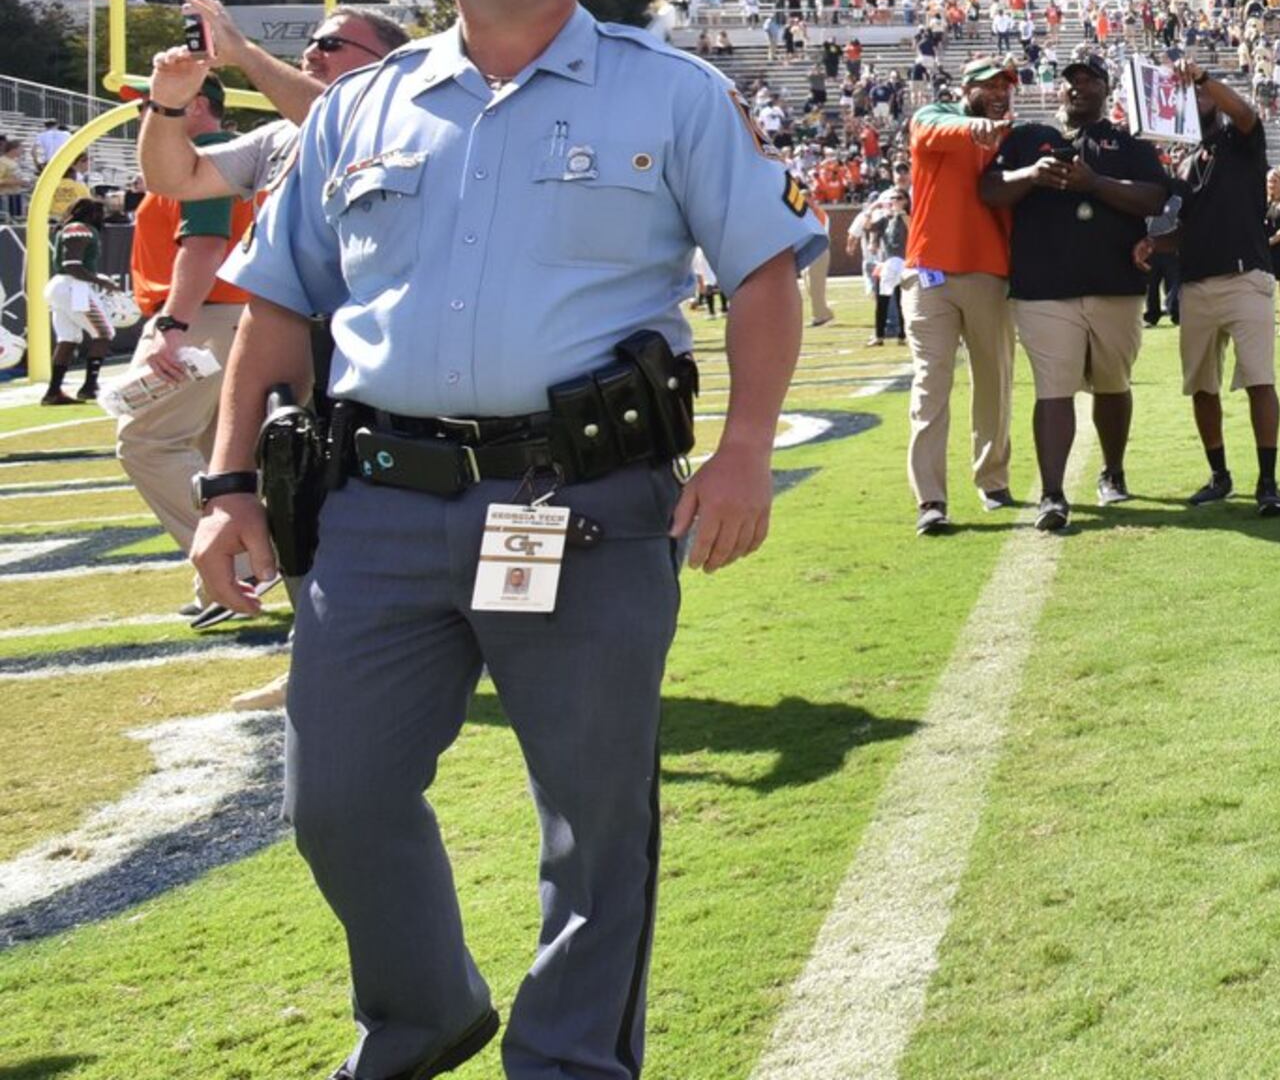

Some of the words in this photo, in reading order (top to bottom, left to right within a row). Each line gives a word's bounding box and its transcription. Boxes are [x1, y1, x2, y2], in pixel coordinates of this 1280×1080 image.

[491, 512, 535, 521] GEORGIA
[540, 514, 565, 522] TECH
[504, 535, 543, 556] GT
